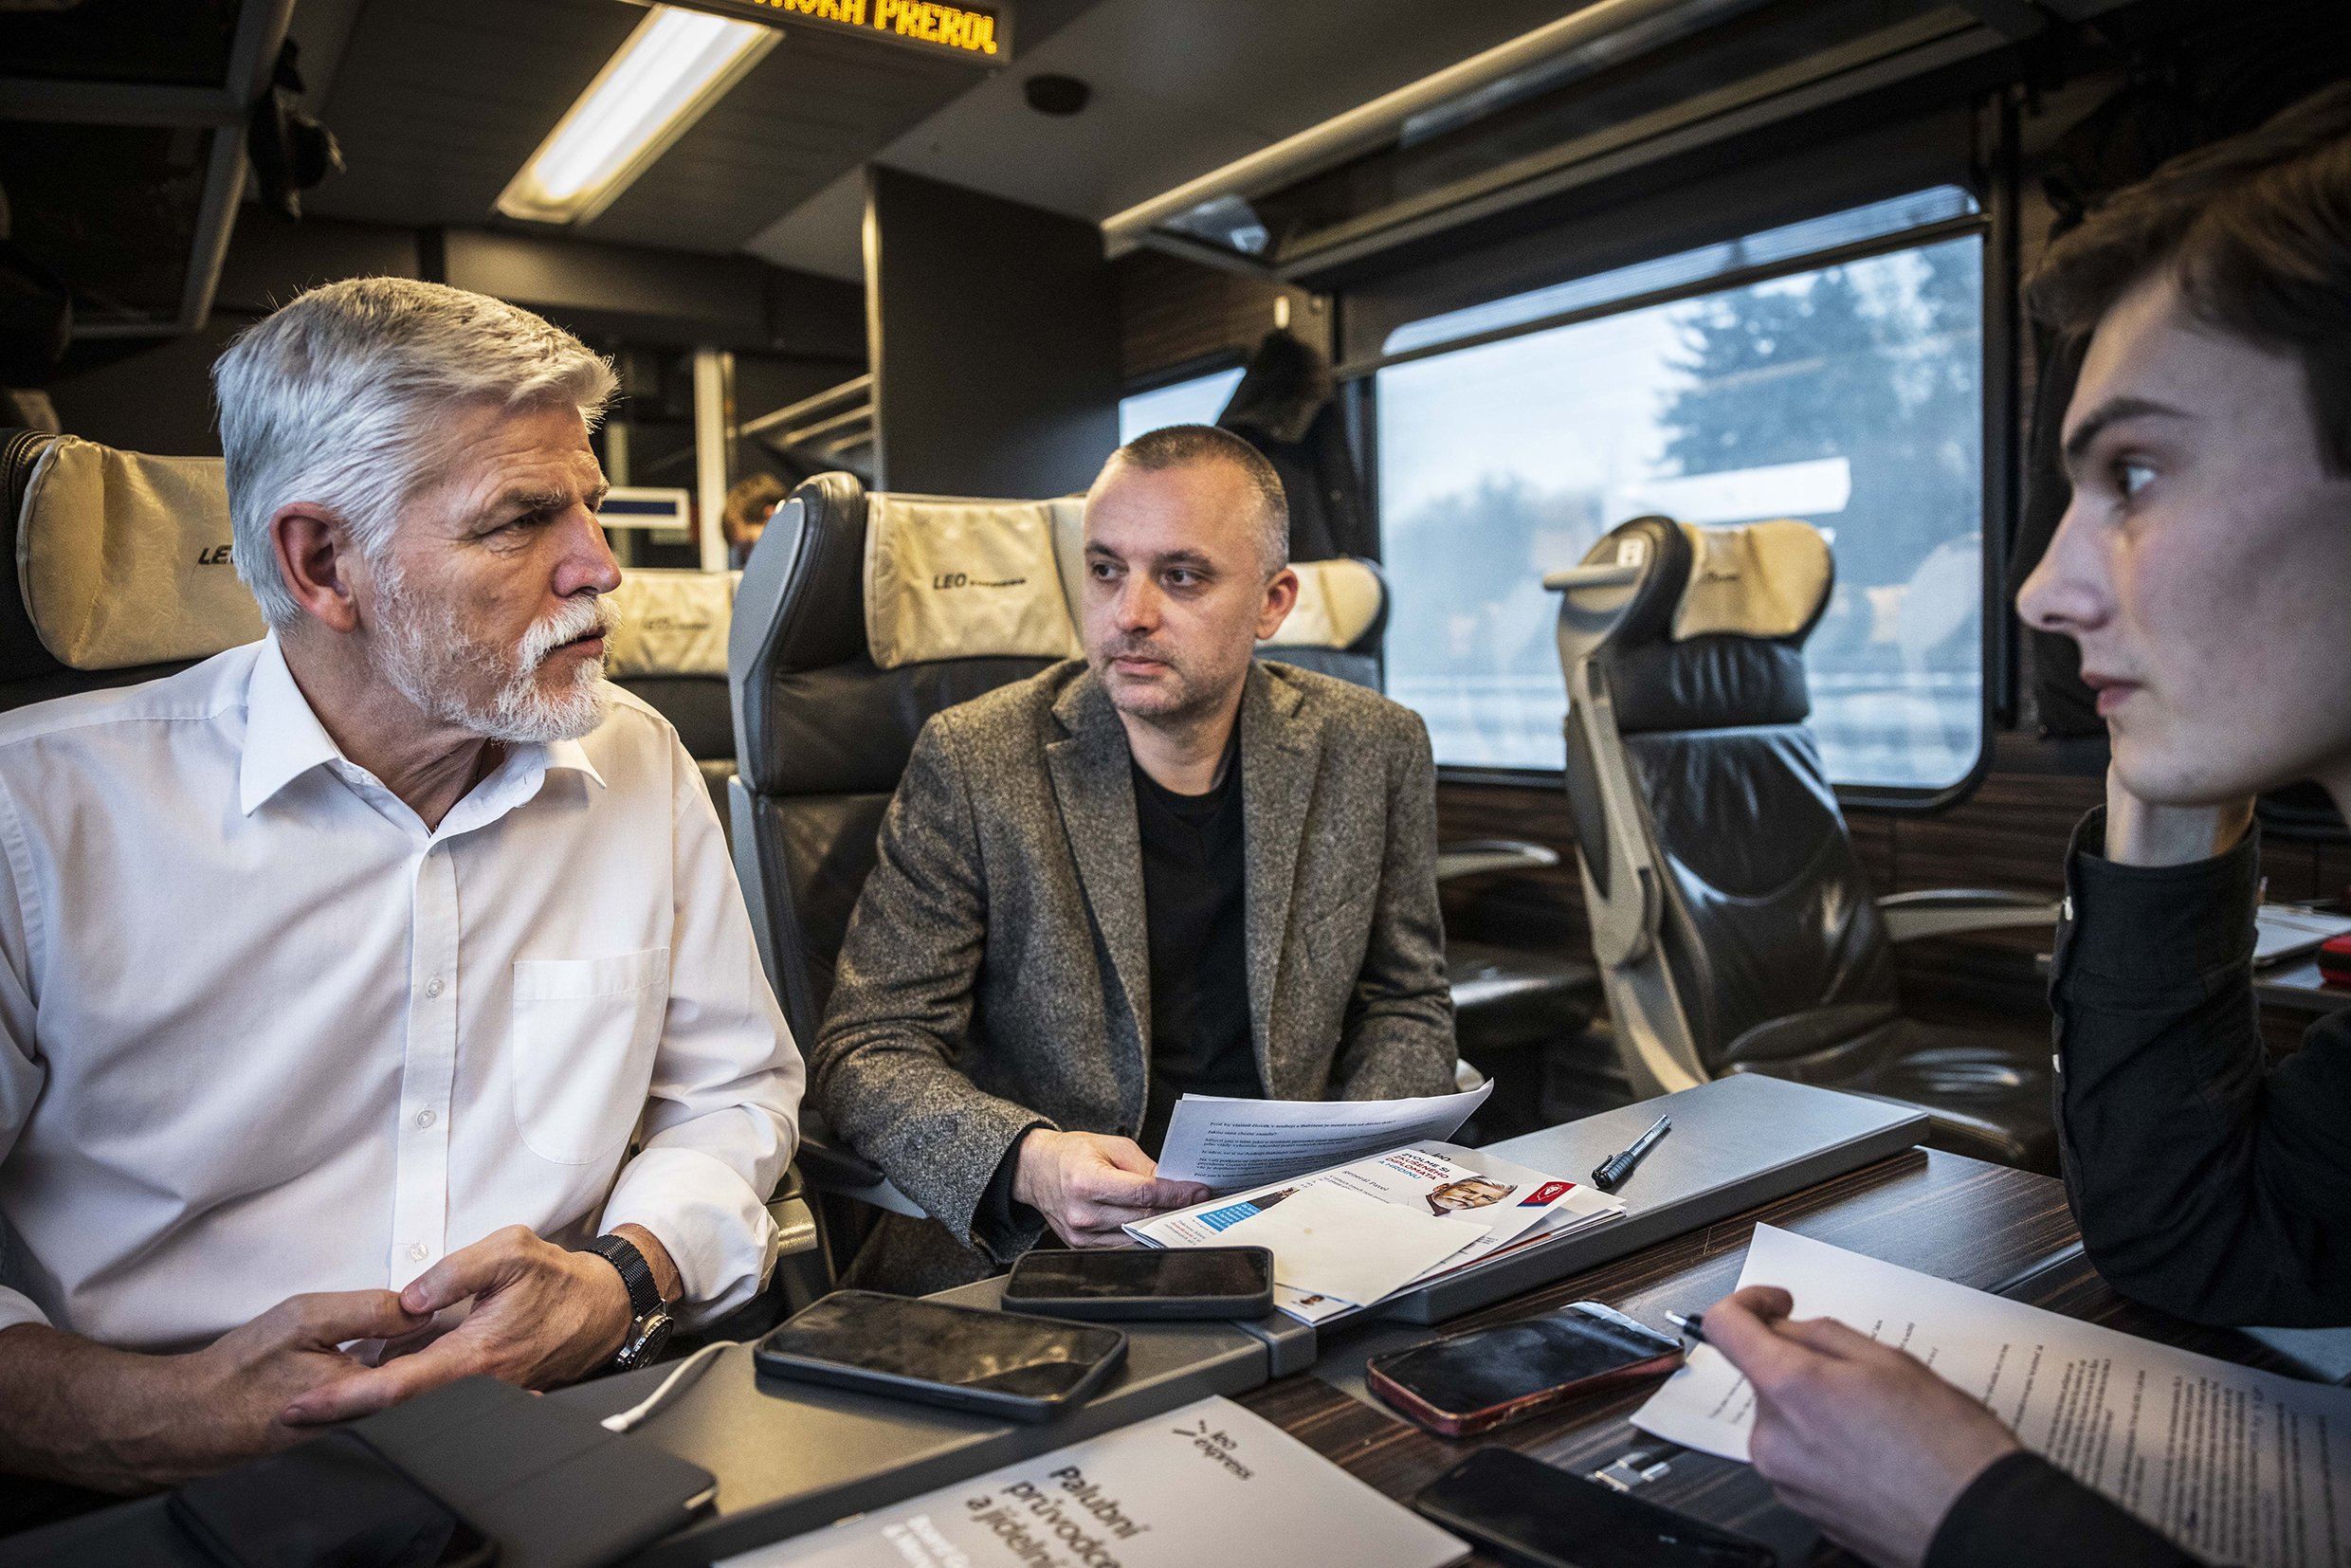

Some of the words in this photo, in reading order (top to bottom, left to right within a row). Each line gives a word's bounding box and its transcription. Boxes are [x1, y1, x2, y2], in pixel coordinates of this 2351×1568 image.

[198, 544, 234, 565] LE
[933, 573, 967, 590] LEO
[1385, 1157, 1436, 1180] DIPLOMATA
[1387, 1162, 1422, 1179] HRDINU
[1401, 1152, 1439, 1169] ZVOLME
[1212, 1429, 1237, 1450] leo
[1194, 1438, 1253, 1480] express
[965, 1495, 993, 1511] a
[1048, 1465, 1153, 1540] Palubní
